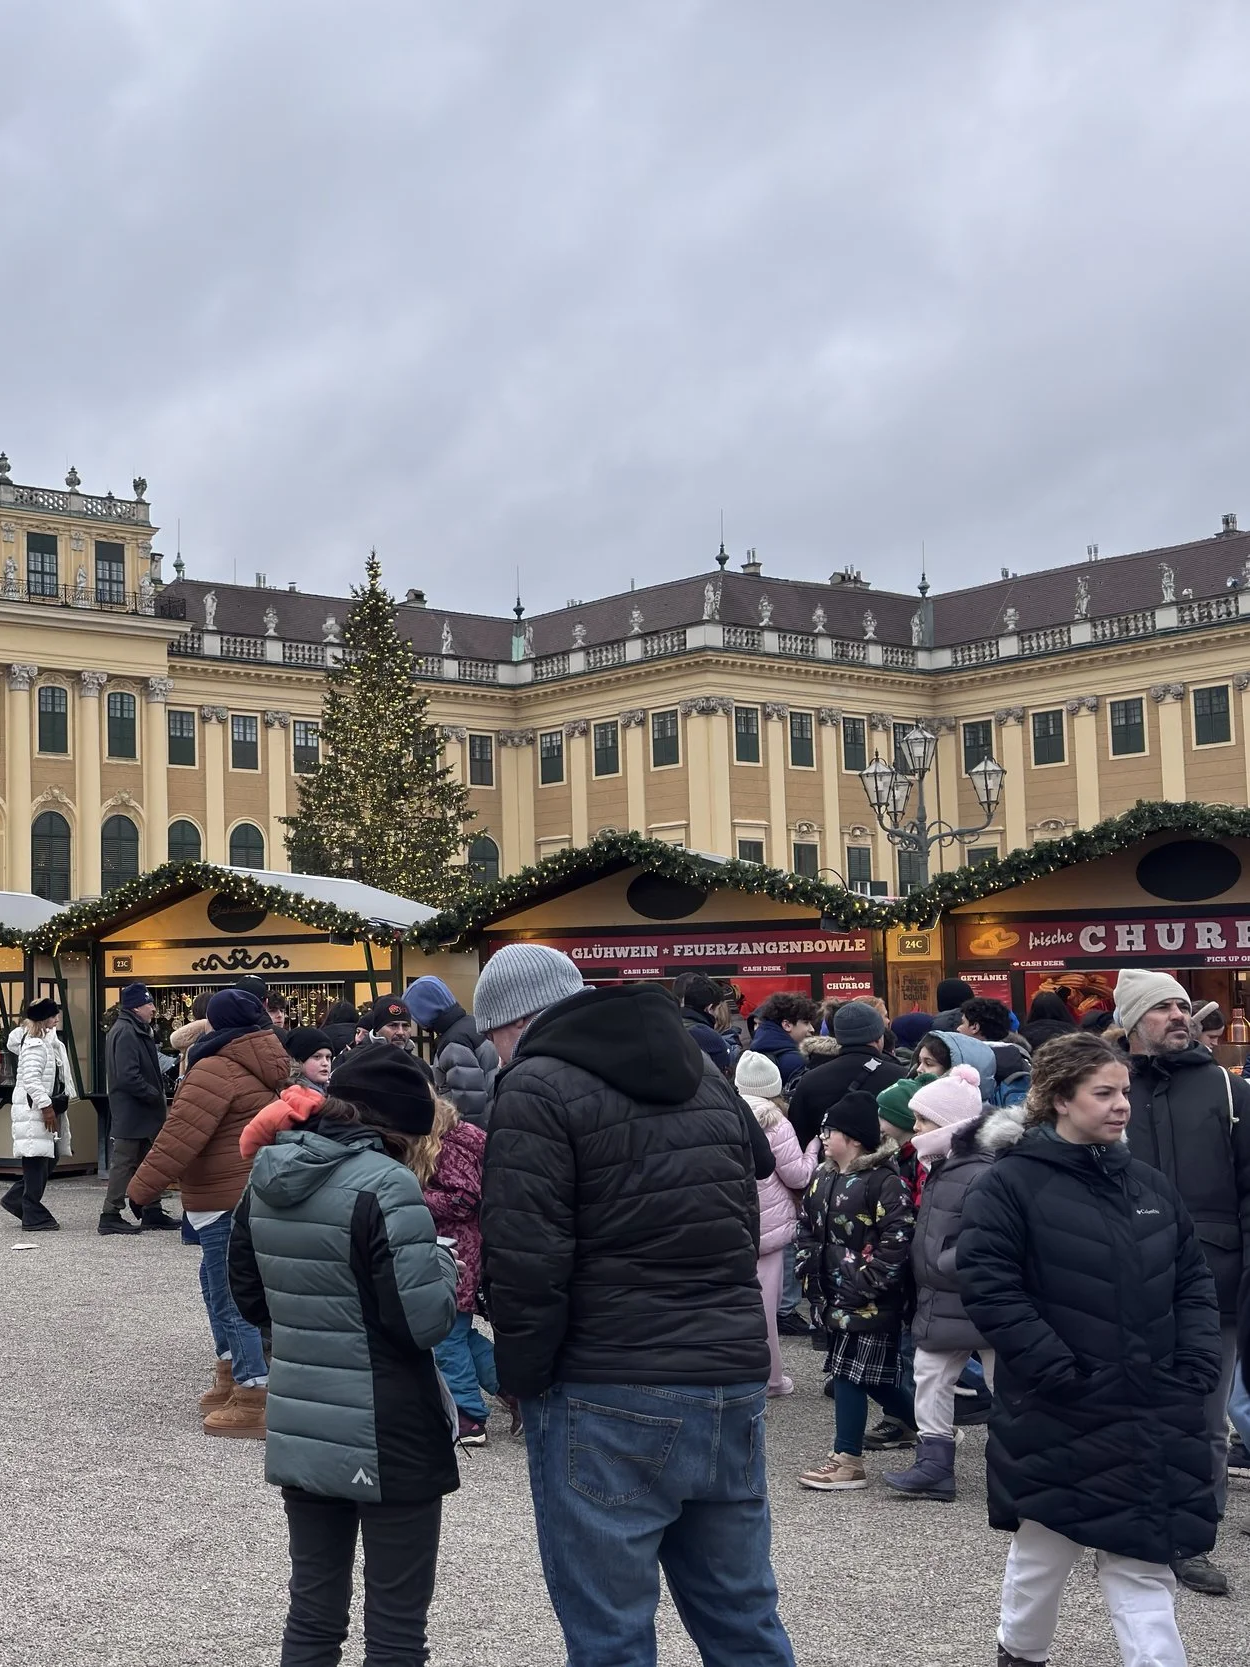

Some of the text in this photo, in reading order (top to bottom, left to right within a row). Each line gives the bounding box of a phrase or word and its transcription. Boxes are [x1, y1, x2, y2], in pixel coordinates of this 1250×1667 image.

[1028, 928, 1074, 950] frische
[572, 938, 866, 959] GLÜHWEIN FEUERZANGENBOWLE
[905, 940, 923, 949] 24C
[960, 972, 1008, 981] GETRÄNKE
[826, 982, 871, 990] CHURROS
